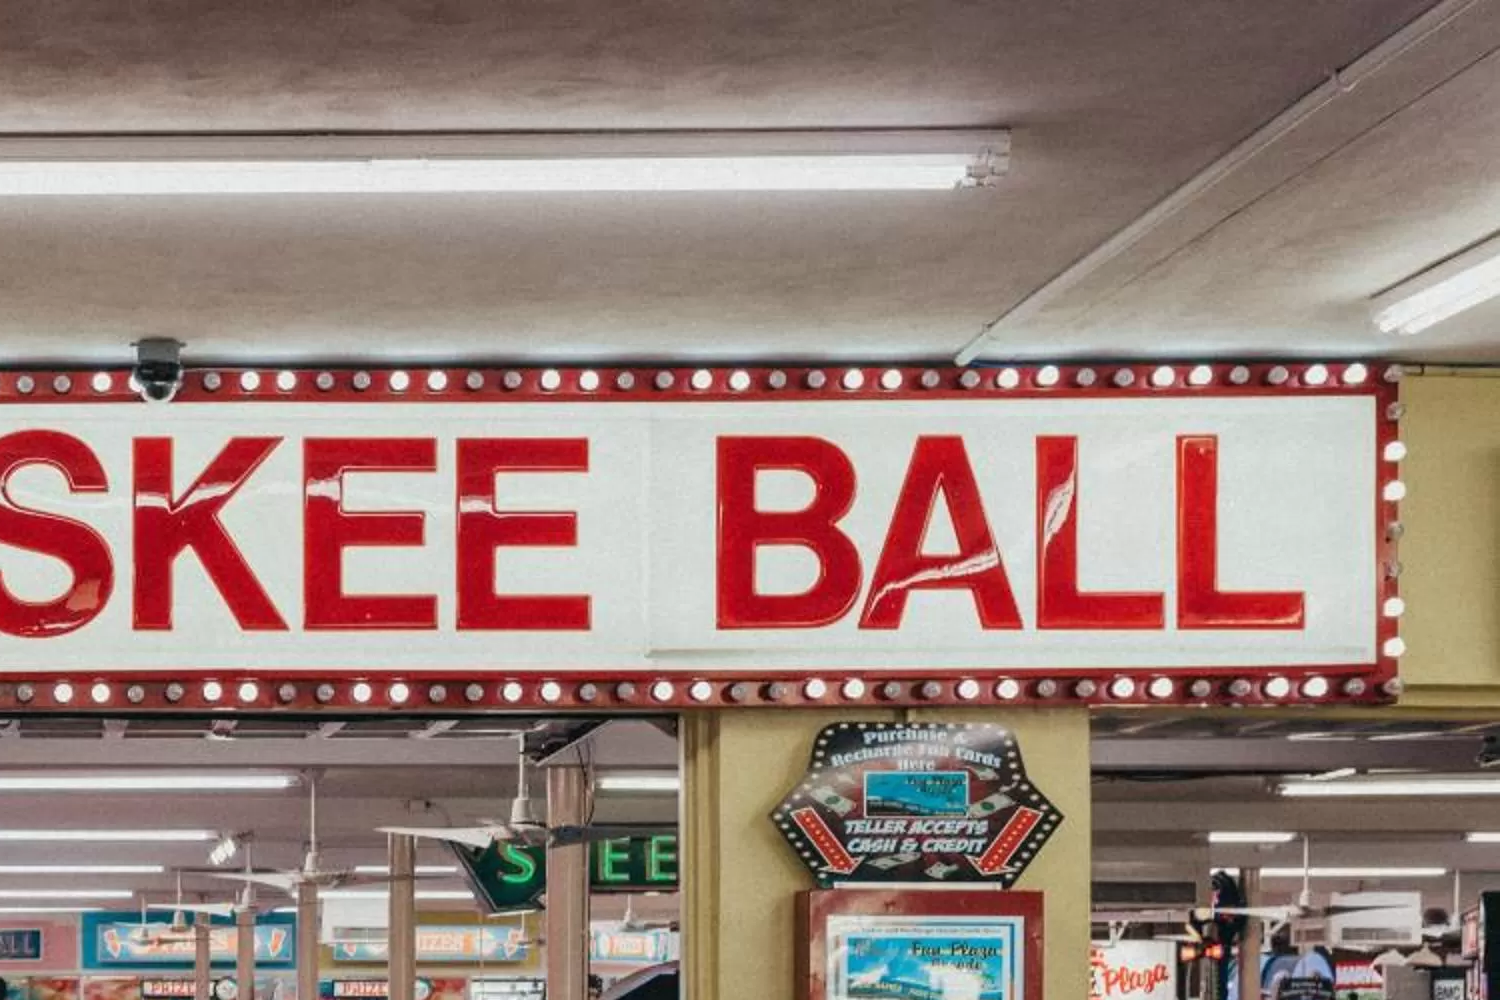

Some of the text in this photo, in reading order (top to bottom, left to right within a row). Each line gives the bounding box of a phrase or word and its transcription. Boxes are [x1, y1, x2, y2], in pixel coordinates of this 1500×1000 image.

[715, 432, 1307, 632] BALL
[863, 728, 947, 745] Purchase
[955, 746, 1002, 768] Cards
[844, 819, 989, 835] TELLER ACCEPTS
[847, 837, 988, 854] CASH & CREDIT
[1102, 964, 1169, 995] Plaza
